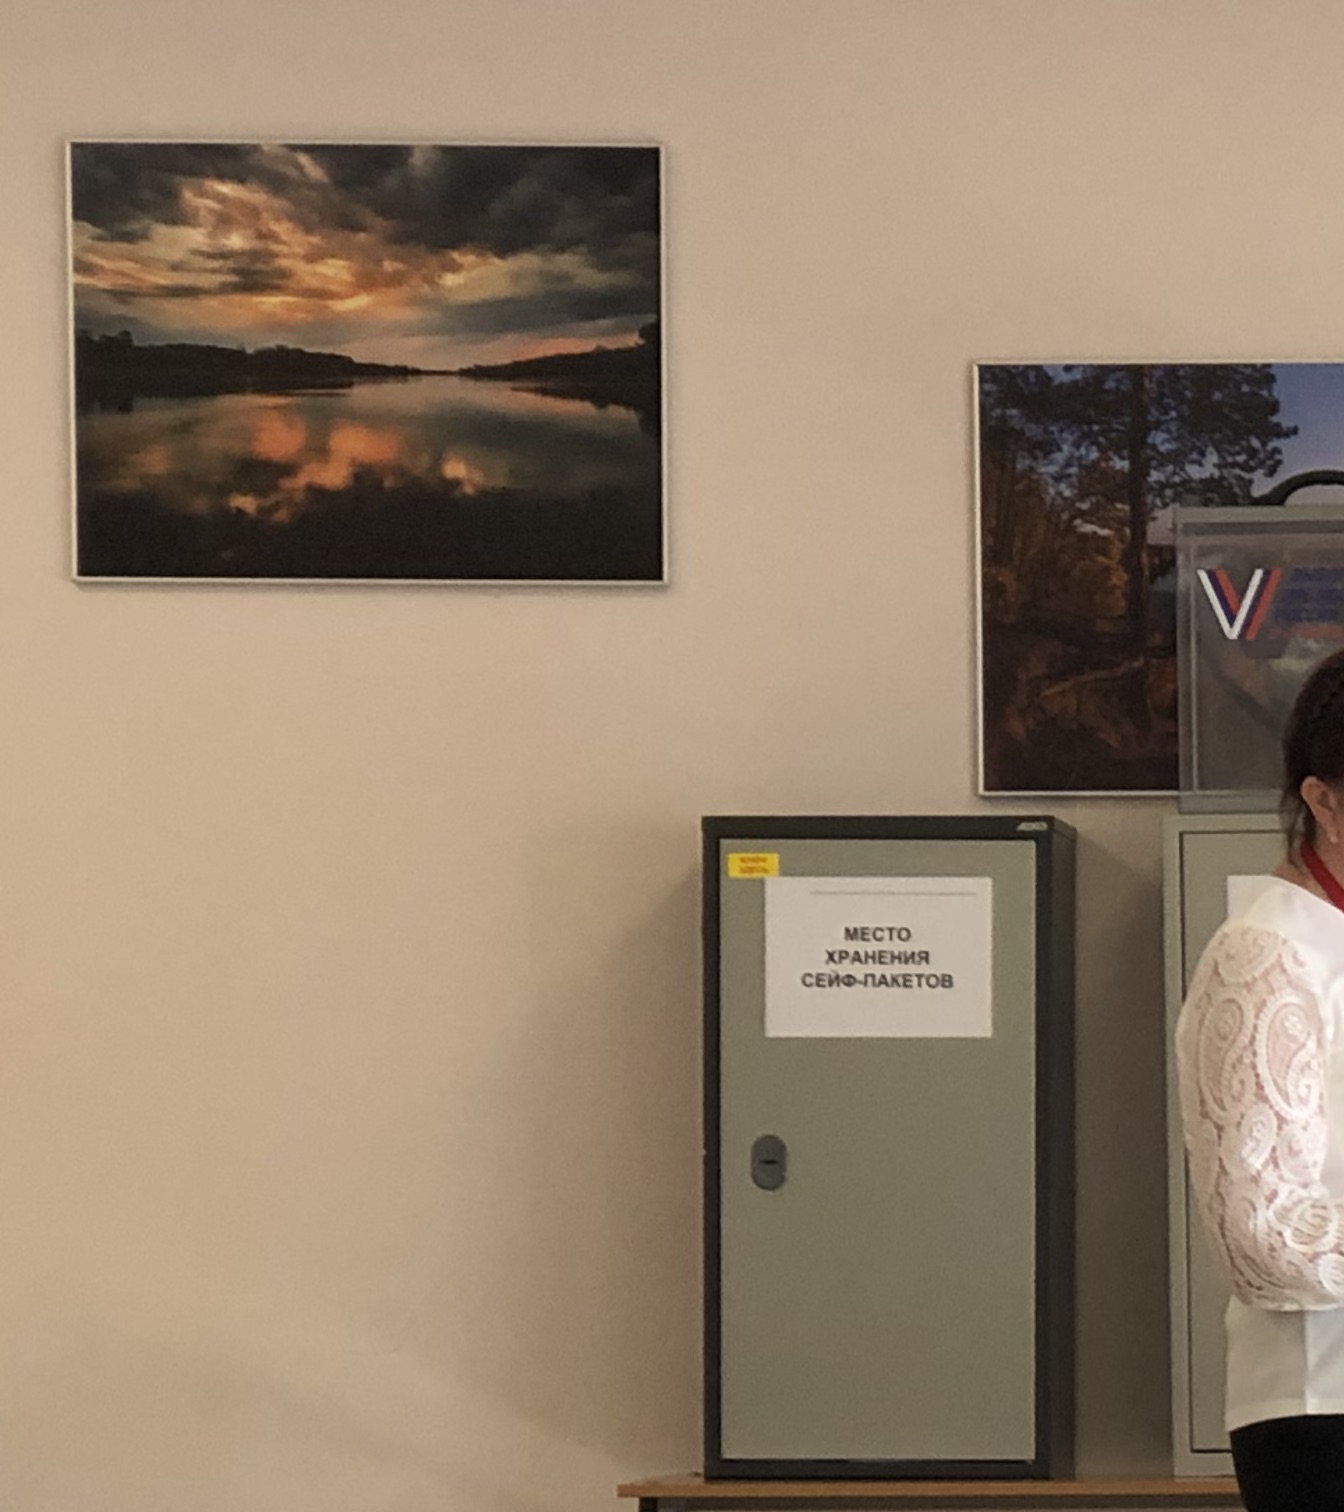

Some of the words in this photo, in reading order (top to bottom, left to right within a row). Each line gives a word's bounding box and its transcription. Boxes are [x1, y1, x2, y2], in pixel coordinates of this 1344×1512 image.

[843, 926, 912, 943] МЕСТО
[824, 949, 931, 966] ХРАНЕНИЯ
[800, 969, 954, 990] СЕЙФ-ПАКЕТОВ
